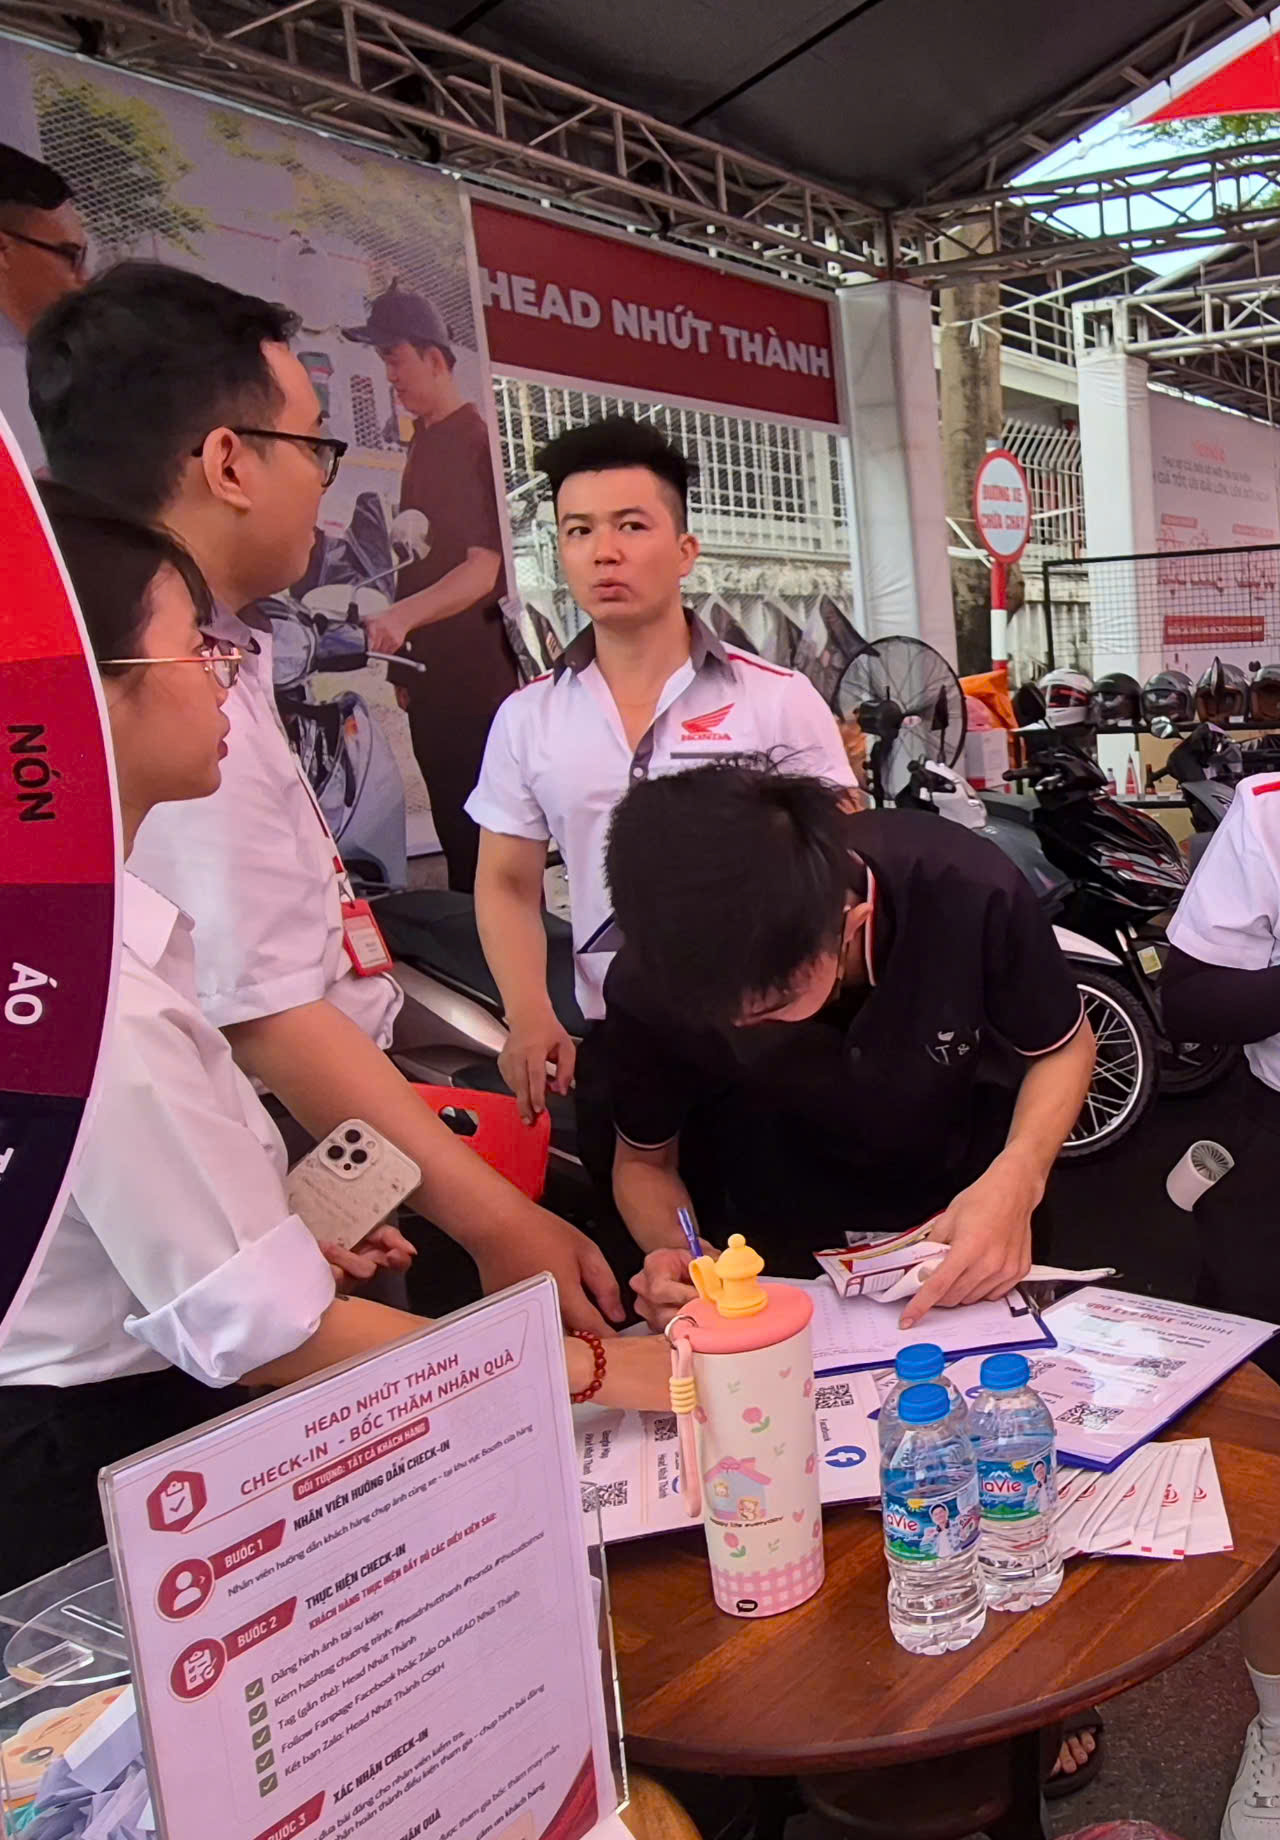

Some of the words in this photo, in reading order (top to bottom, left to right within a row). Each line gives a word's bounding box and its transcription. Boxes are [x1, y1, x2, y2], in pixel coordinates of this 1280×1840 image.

[478, 267, 600, 329] HEAD
[611, 303, 713, 354] NHỨT
[719, 326, 831, 379] THÀNH
[7, 723, 62, 823] NÓN
[3, 961, 58, 1026] ÁO
[240, 1441, 329, 1496] CHECK-IN
[349, 1411, 384, 1443] BỐC
[389, 1390, 433, 1423] THĂM
[437, 1366, 480, 1399] NHẬN
[484, 1349, 515, 1378] QUÀ
[304, 1406, 351, 1438] HEAD
[356, 1380, 402, 1413] NHỨT
[404, 1353, 459, 1389] THÀNH
[293, 1503, 324, 1532] NHÂN
[324, 1492, 350, 1516] VIÊN
[351, 1473, 384, 1502] HƯỚNG
[385, 1457, 406, 1482] DẪN
[406, 1439, 451, 1471] CHECK-IN
[224, 1543, 256, 1569] BƯỚC
[256, 1538, 264, 1551] 1
[227, 1578, 254, 1597] Nhân
[255, 1566, 275, 1583] viên
[275, 1549, 306, 1572] hướng
[305, 1540, 323, 1555] dẫn
[323, 1525, 349, 1545] khách
[349, 1513, 372, 1530] hàng
[304, 1585, 334, 1611] THỰC
[335, 1570, 359, 1594] HIỆN
[360, 1543, 406, 1578] CHECK-IN
[237, 1622, 268, 1649] BƯỚC
[269, 1615, 278, 1629] 2
[270, 1660, 298, 1685] Đăng
[298, 1648, 320, 1667] hình
[321, 1636, 339, 1653] ảnh
[364, 1610, 385, 1627] kiện
[308, 1608, 338, 1631] KHÁCH
[338, 1593, 361, 1614] HÀNG
[274, 1689, 298, 1709] Kèm
[298, 1664, 337, 1693] hashtag
[277, 1714, 297, 1730] Tag
[342, 1666, 367, 1689] Head
[367, 1653, 390, 1673] Nhứt
[390, 1635, 417, 1657] Thành
[280, 1727, 313, 1754] Follow
[314, 1701, 354, 1732] Fanpage
[354, 1673, 396, 1705] Facebook
[397, 1658, 418, 1677] hoặc
[419, 1646, 437, 1663] Zalo
[437, 1635, 451, 1649] OA
[452, 1618, 476, 1640] HEAD
[322, 1732, 345, 1752] Zalo:
[345, 1712, 370, 1735] Head
[370, 1698, 393, 1718] Nhứt
[393, 1680, 421, 1702] Thành
[421, 1661, 445, 1683] CSKH
[332, 1781, 354, 1805] XÁC
[355, 1760, 384, 1789] NHẬN
[384, 1727, 429, 1767] CHECK-IN
[374, 1784, 392, 1800] cho
[299, 1812, 307, 1826] 3
[423, 1807, 442, 1831] QUÀ
